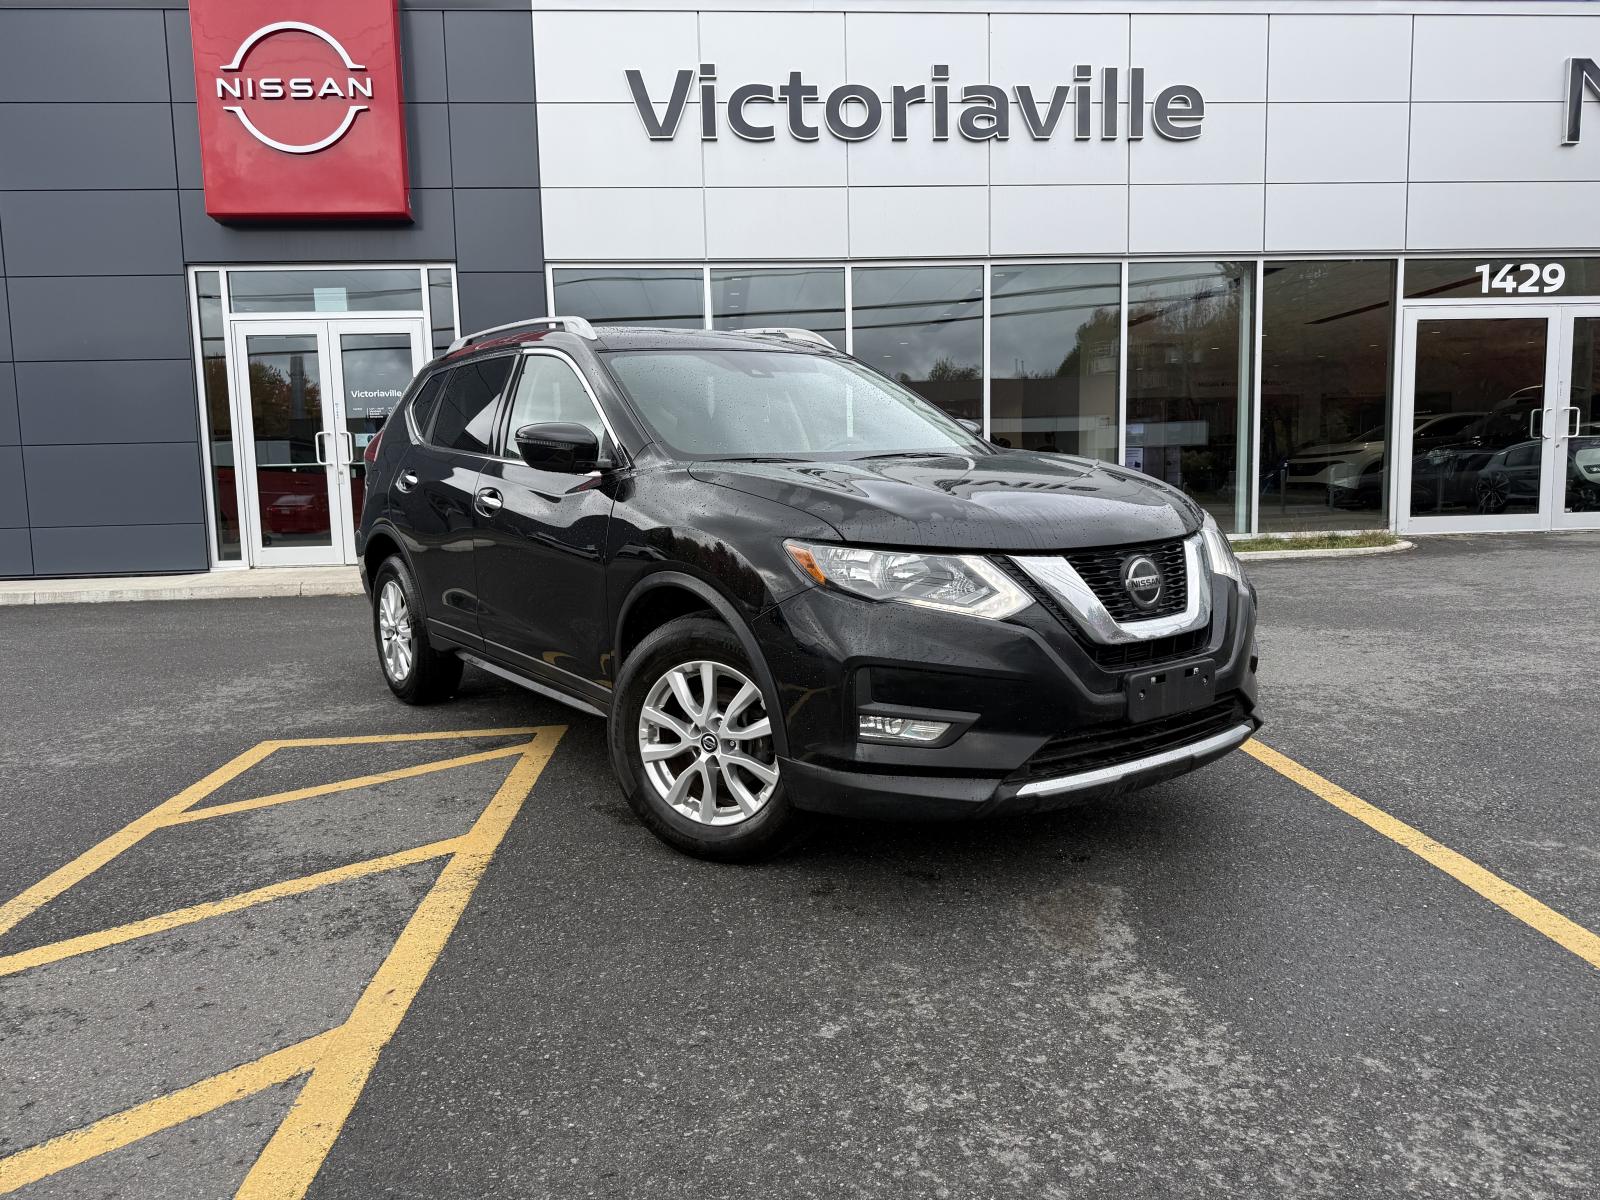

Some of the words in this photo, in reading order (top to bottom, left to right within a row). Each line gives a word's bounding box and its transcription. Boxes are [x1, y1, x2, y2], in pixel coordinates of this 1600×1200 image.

[216, 77, 373, 98] NISSAN
[624, 63, 1206, 142] Victoriaville
[1475, 262, 1566, 294] 1429
[351, 389, 402, 398] Victoriaville
[1131, 577, 1160, 588] NISSAN
